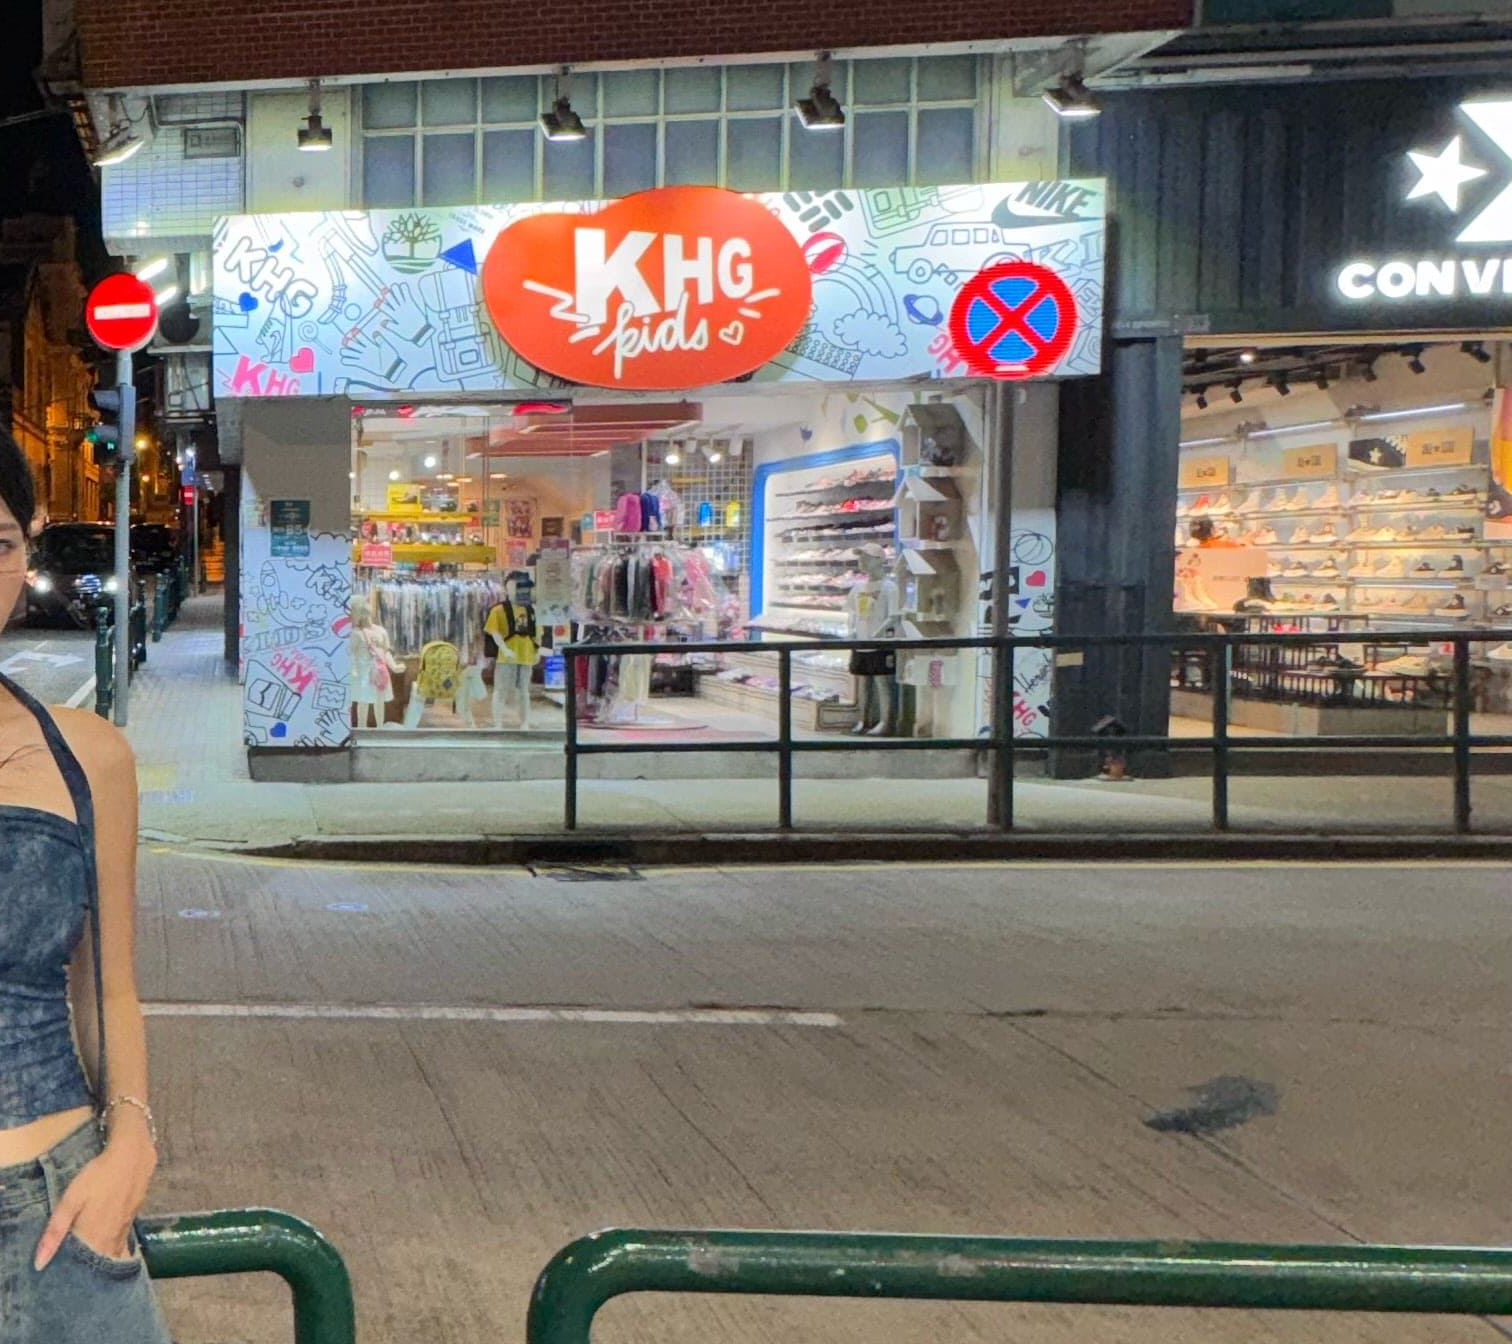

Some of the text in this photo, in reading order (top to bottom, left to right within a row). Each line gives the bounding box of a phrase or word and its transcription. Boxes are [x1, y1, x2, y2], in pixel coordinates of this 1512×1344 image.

[1014, 181, 1098, 219] NIKE
[224, 236, 318, 318] KHG
[575, 227, 753, 328] KHG
[592, 290, 709, 380] kids
